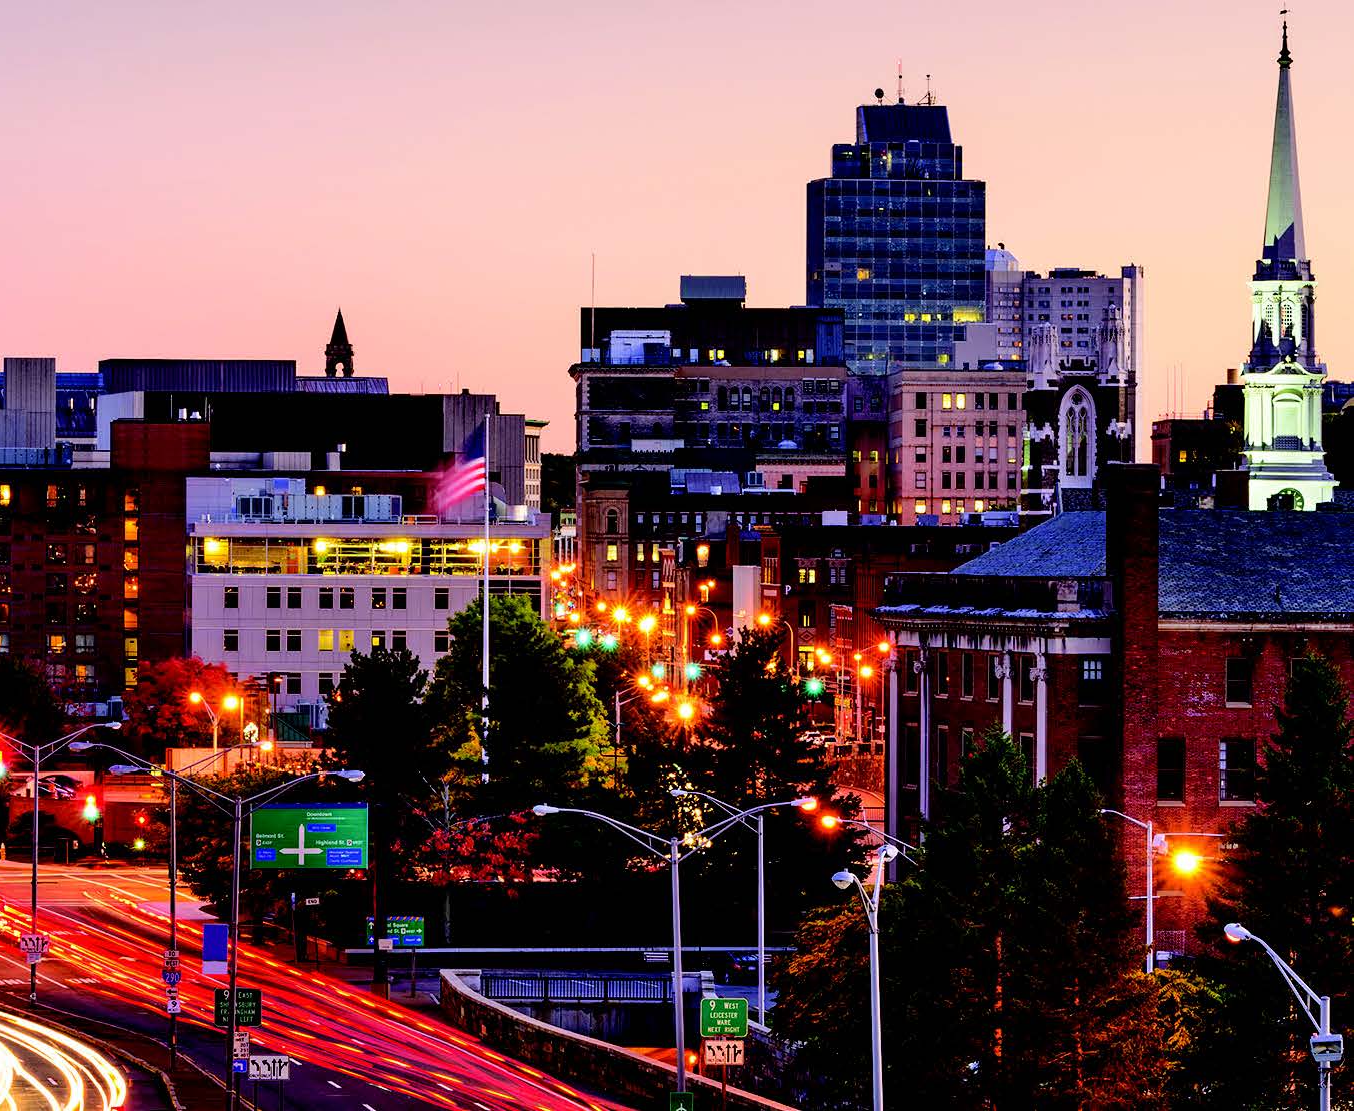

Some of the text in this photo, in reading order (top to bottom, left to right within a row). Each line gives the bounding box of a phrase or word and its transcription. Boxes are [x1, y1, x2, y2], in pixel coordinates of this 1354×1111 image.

[166, 972, 179, 983] 290
[224, 990, 230, 1000] 9
[710, 1000, 715, 1010] 9
